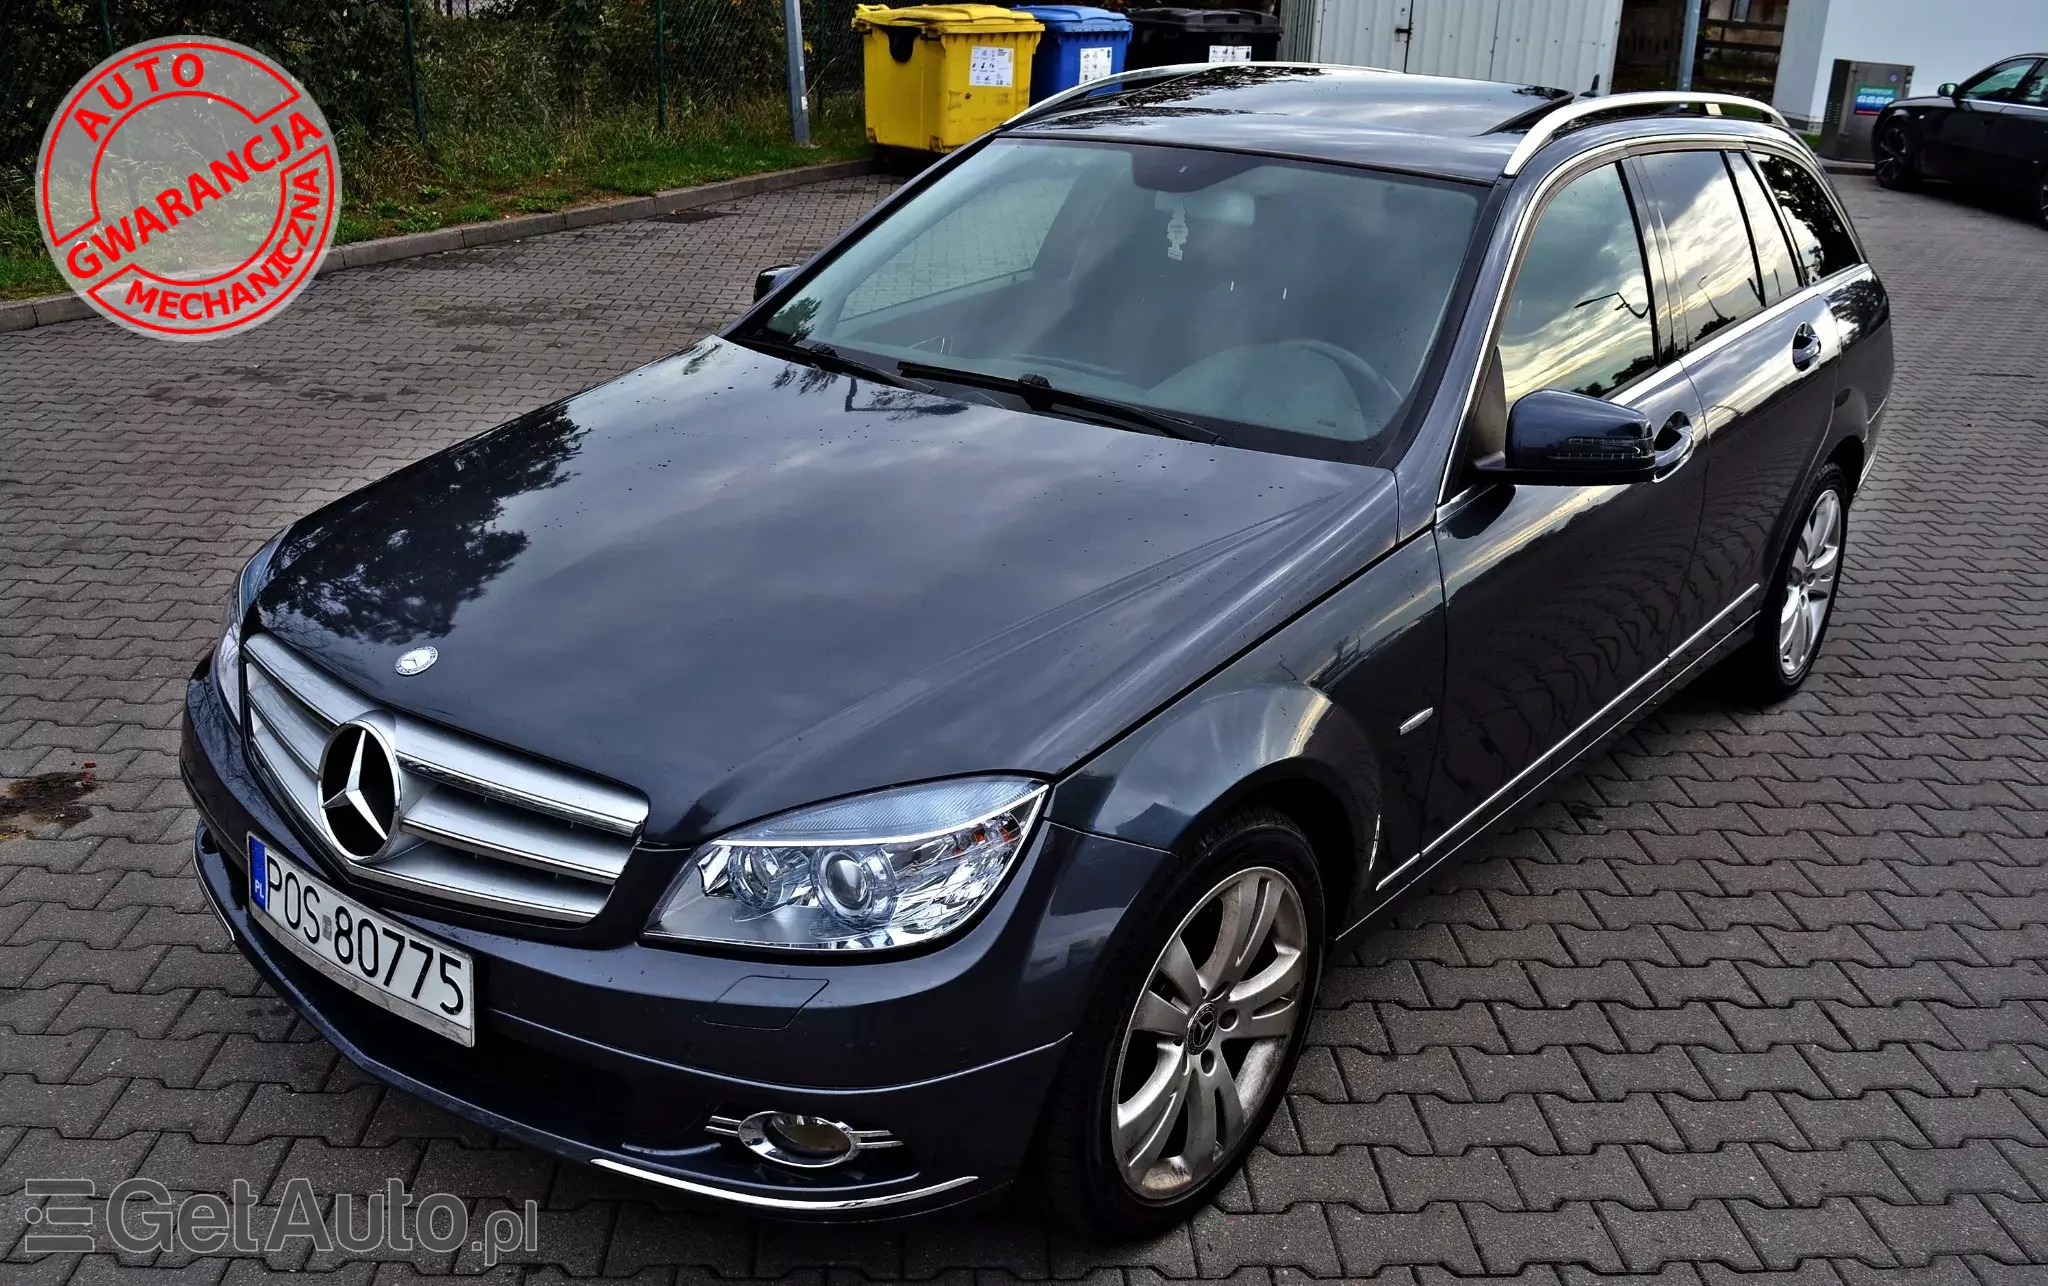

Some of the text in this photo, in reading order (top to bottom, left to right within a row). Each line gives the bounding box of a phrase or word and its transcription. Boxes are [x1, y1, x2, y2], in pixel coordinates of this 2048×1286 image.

[254, 879, 265, 899] PL
[266, 854, 464, 1016] POS 80775
